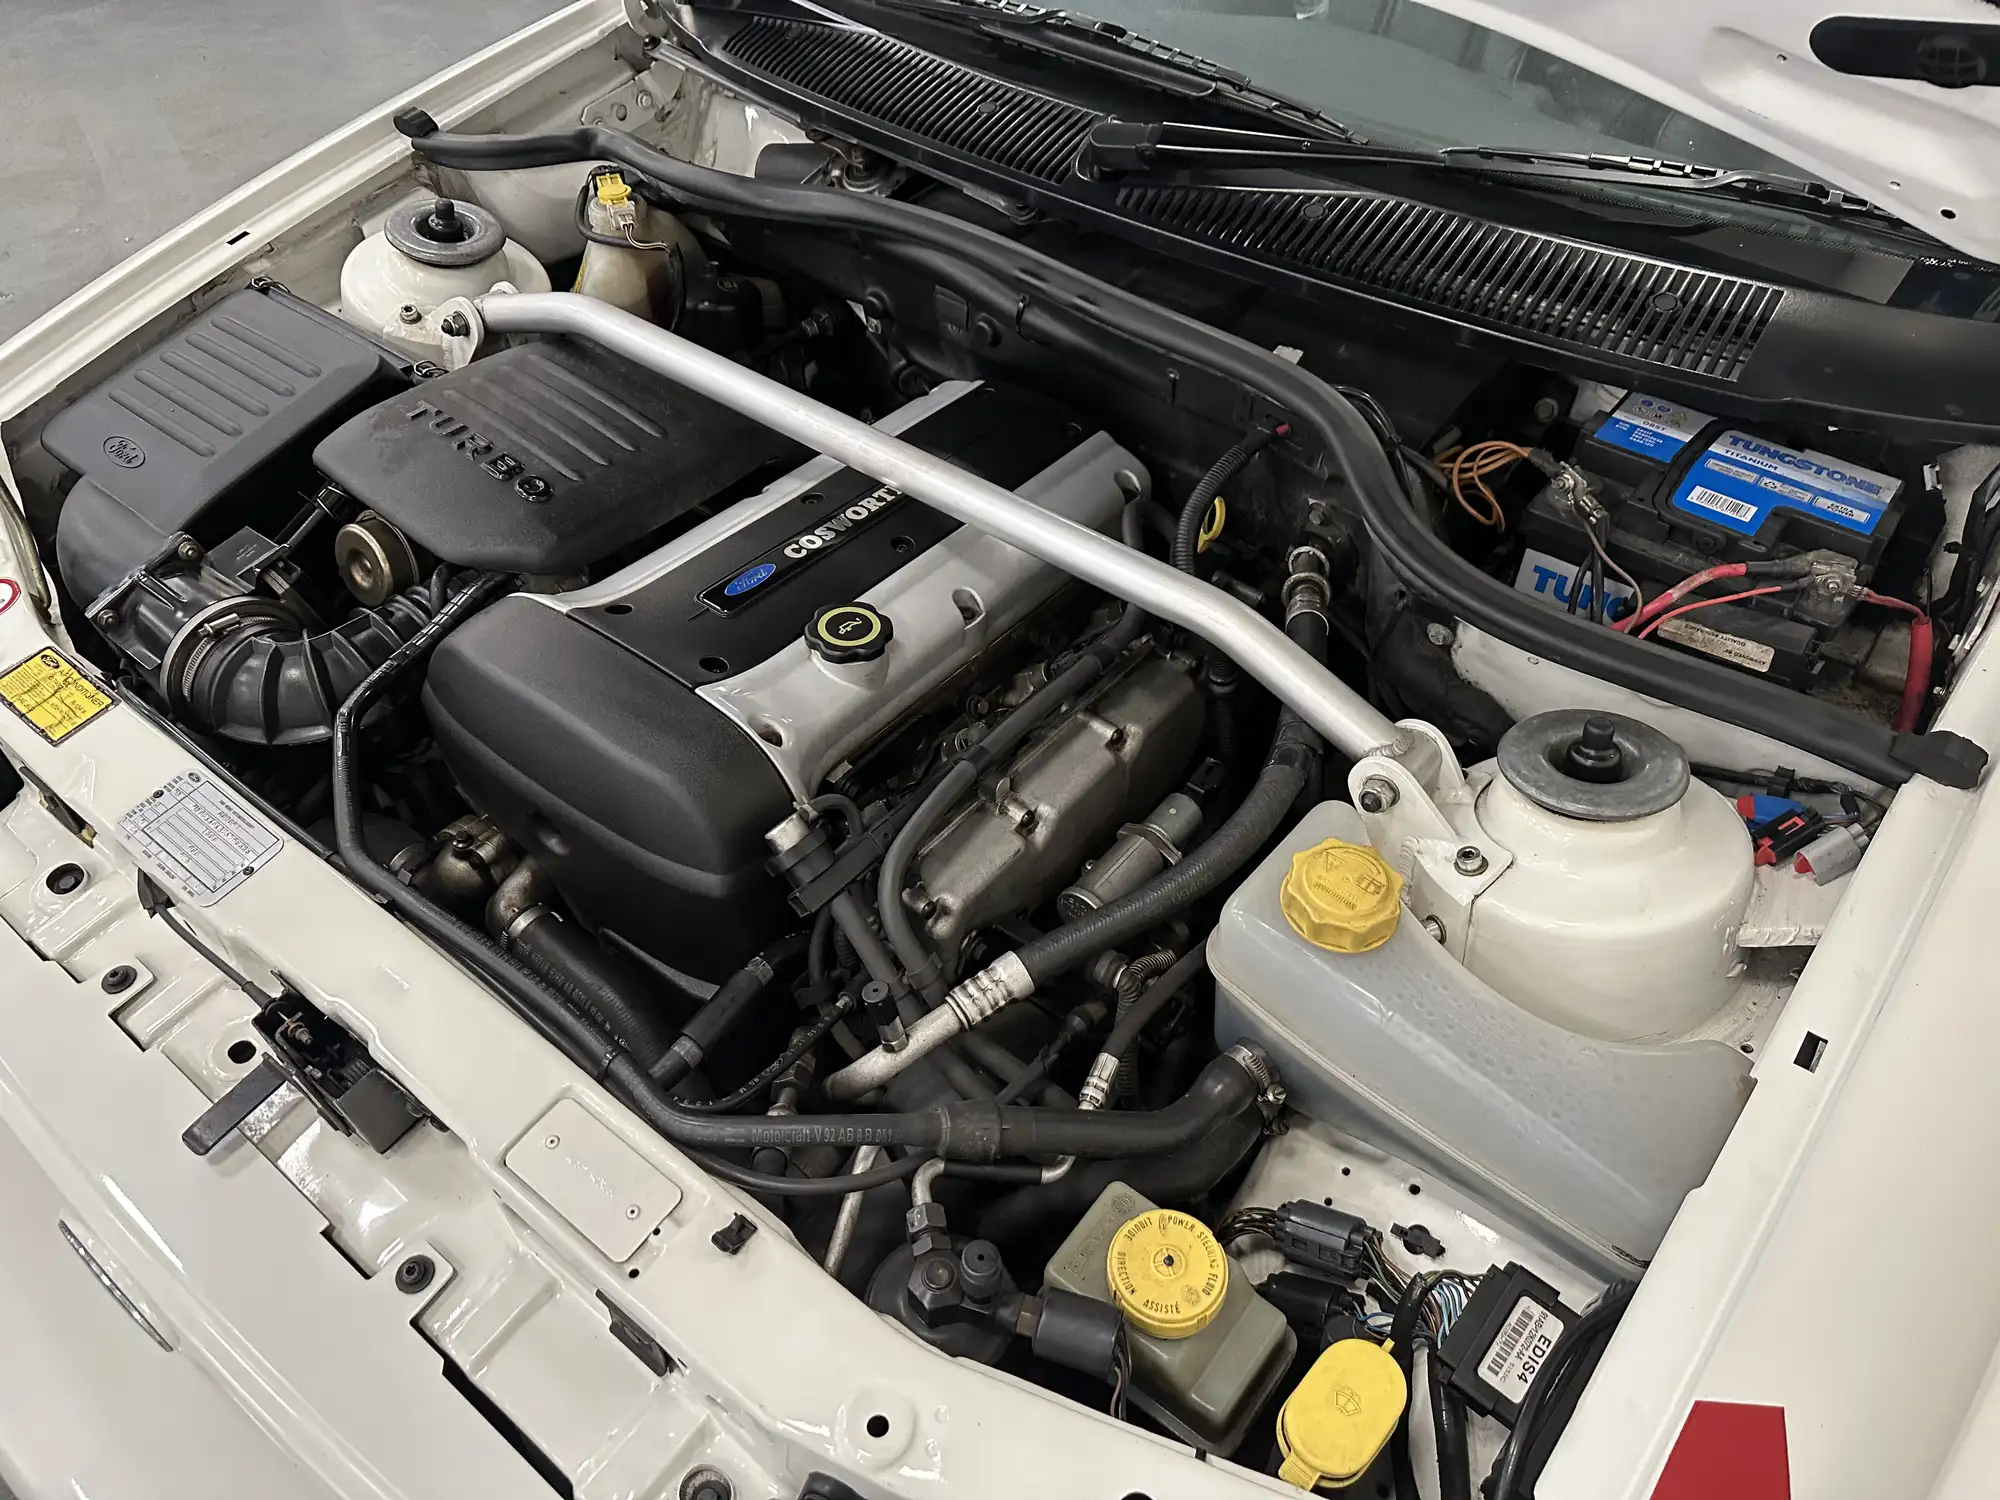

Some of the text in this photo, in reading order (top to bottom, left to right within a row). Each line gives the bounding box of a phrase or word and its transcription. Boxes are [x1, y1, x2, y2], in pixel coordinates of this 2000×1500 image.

[109, 438, 143, 466] Ford
[406, 400, 554, 503] TURBO
[1724, 449, 1778, 471] TITANIUM
[1728, 435, 1883, 495] TUNGSTONE
[1826, 505, 1855, 517] POWER
[1830, 502, 1854, 513] EXTRA
[735, 569, 768, 591] Ford
[1720, 635, 1746, 647] QUALITY
[751, 1126, 810, 1143] Motorcraft
[1167, 1214, 1219, 1296] POWER STEERING FLUID
[1116, 1251, 1138, 1296] DIRECTION
[1142, 1298, 1181, 1315] ASSISTÉ
[1516, 1334, 1552, 1385] EDIS4
